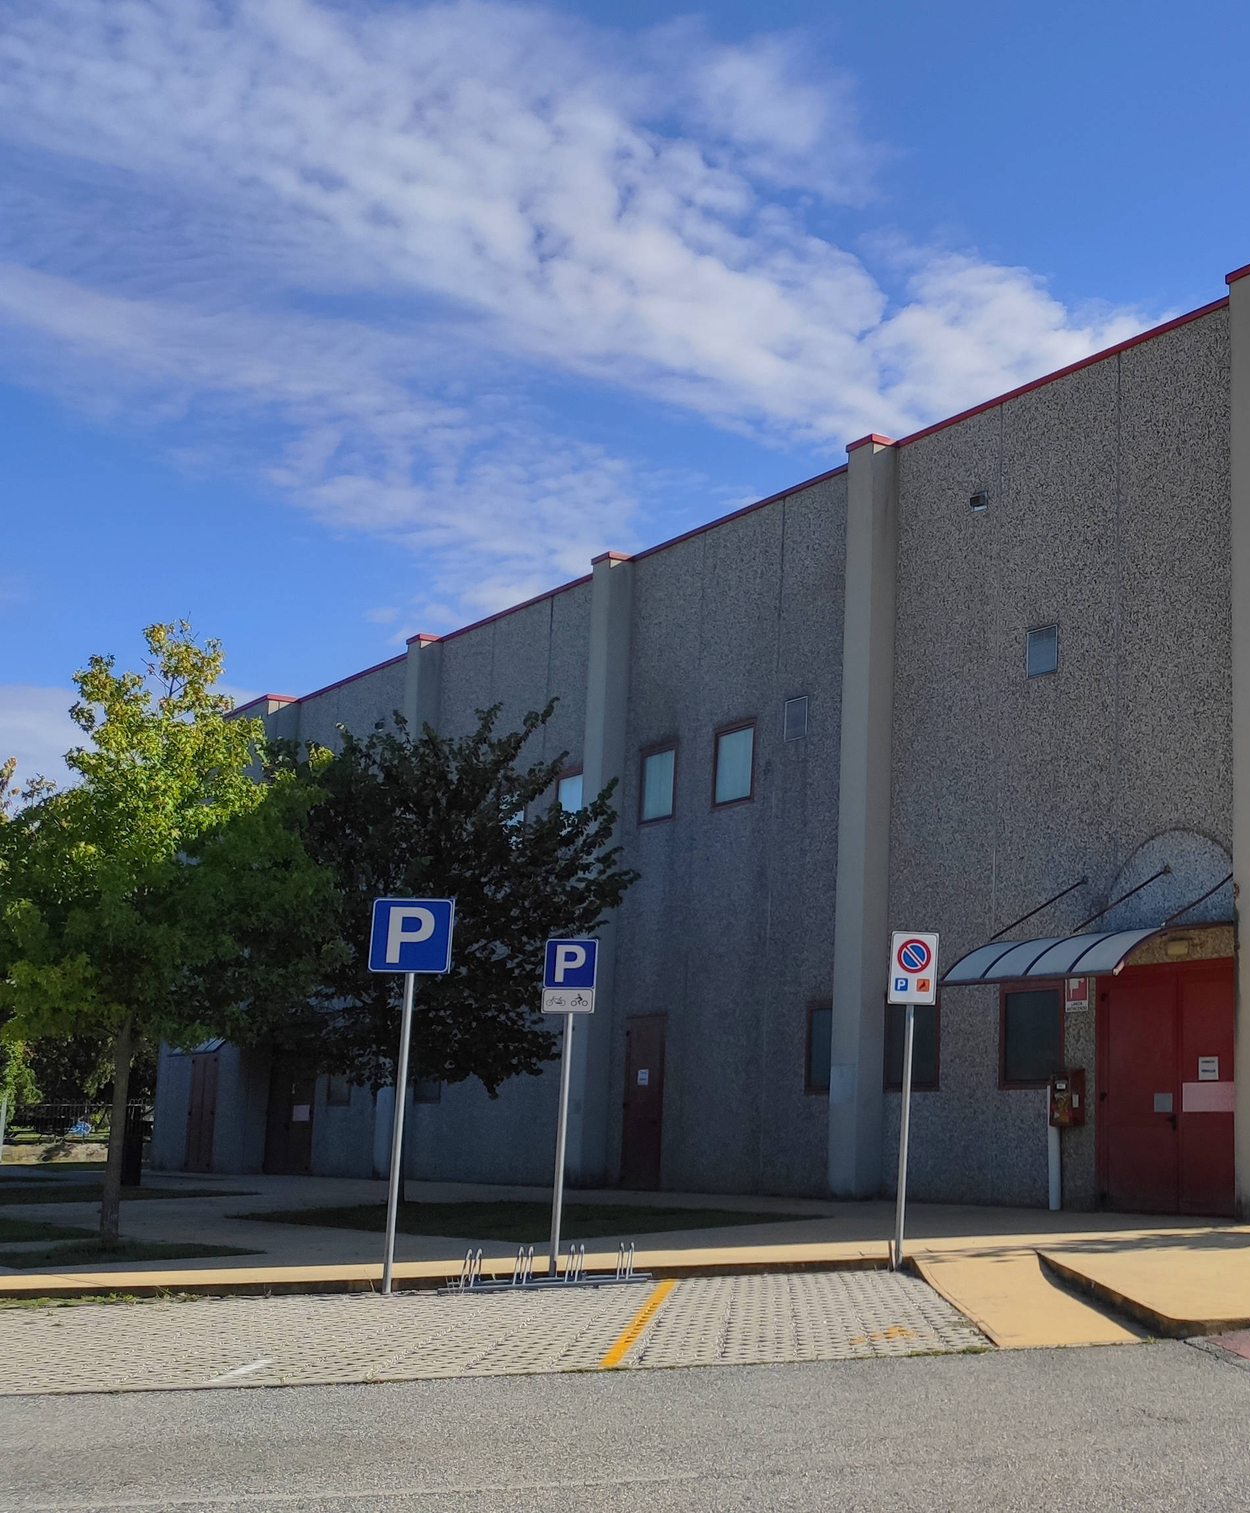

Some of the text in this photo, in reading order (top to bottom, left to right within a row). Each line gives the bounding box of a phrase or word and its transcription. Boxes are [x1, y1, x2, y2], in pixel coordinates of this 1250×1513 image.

[386, 906, 435, 964] P
[554, 944, 586, 983] P
[897, 979, 906, 990] P
